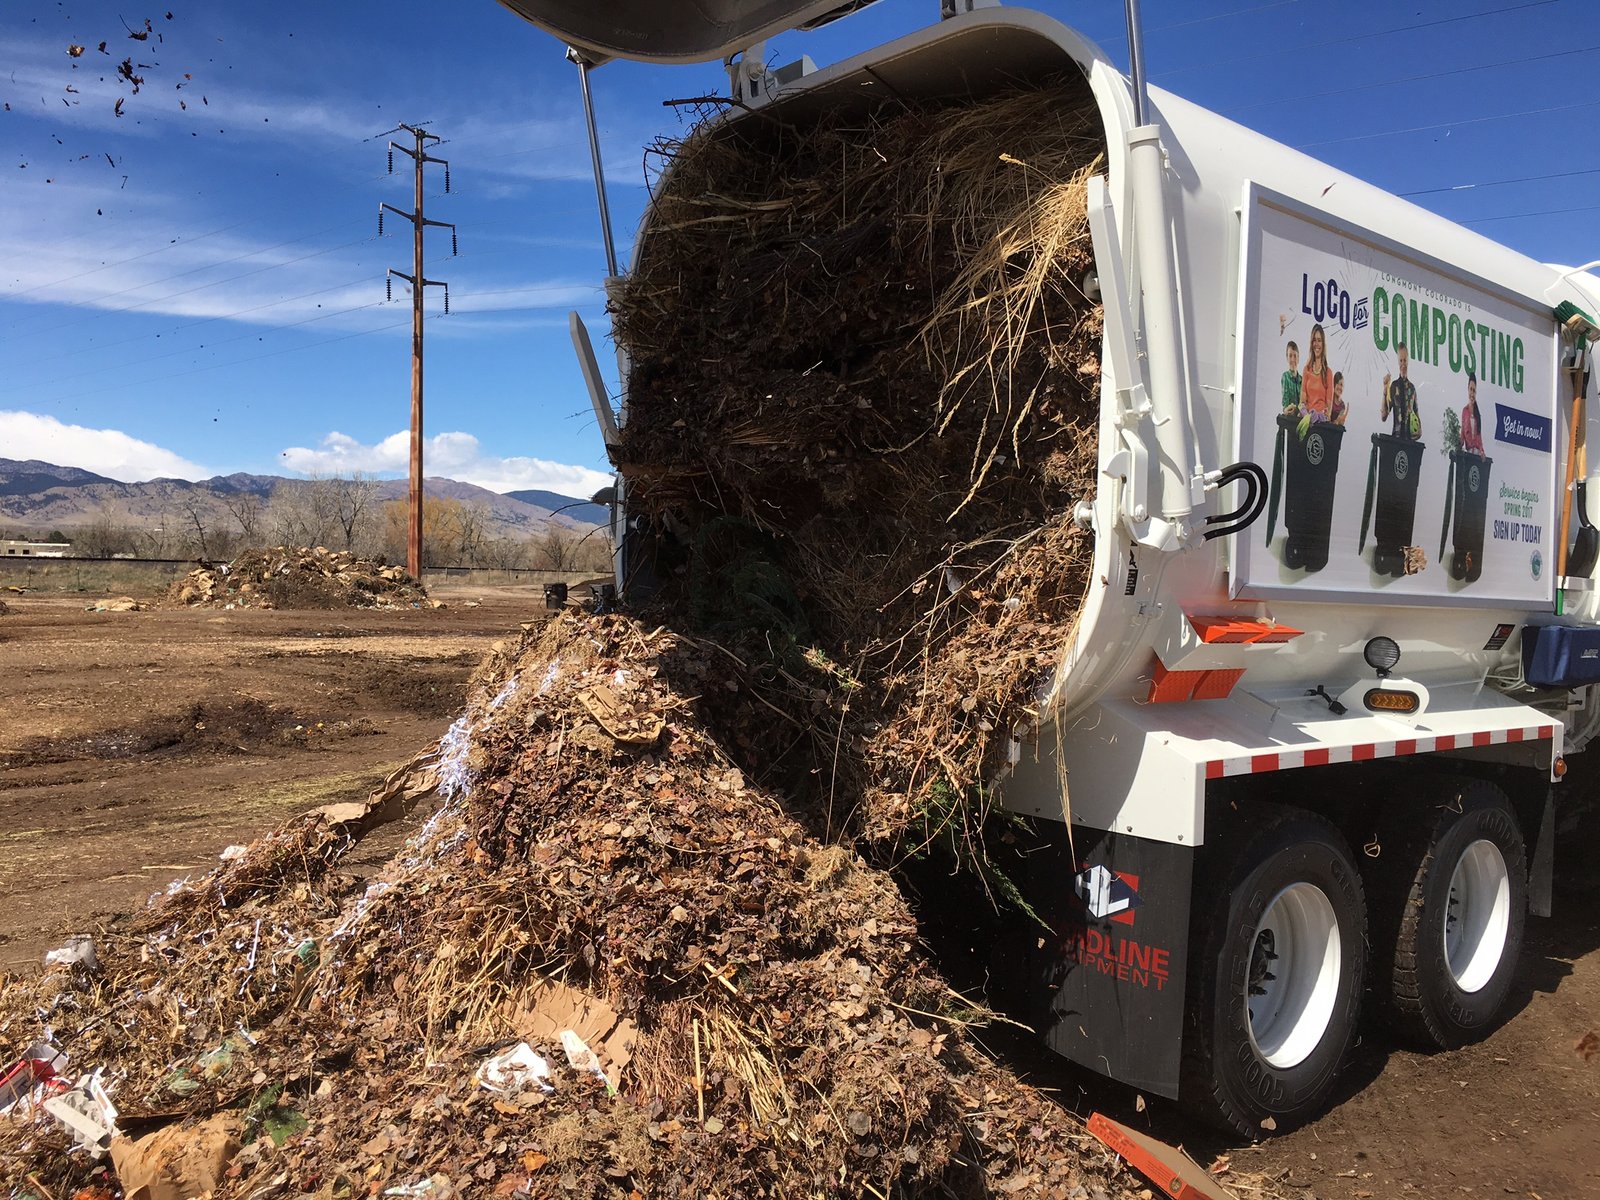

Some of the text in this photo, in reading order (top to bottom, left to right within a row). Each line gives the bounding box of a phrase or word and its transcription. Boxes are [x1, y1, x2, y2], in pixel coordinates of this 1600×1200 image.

[1381, 272, 1472, 312] LONGMONT COLORADO IS
[1353, 303, 1369, 329] for
[1373, 286, 1524, 394] COMPOSTING
[1503, 416, 1543, 440] Get in now!
[1500, 481, 1539, 505] Service begins
[1504, 502, 1533, 519] SPRING 2017
[1493, 519, 1542, 544] SIGN UP TODAY
[1077, 950, 1169, 991] IPMENT
